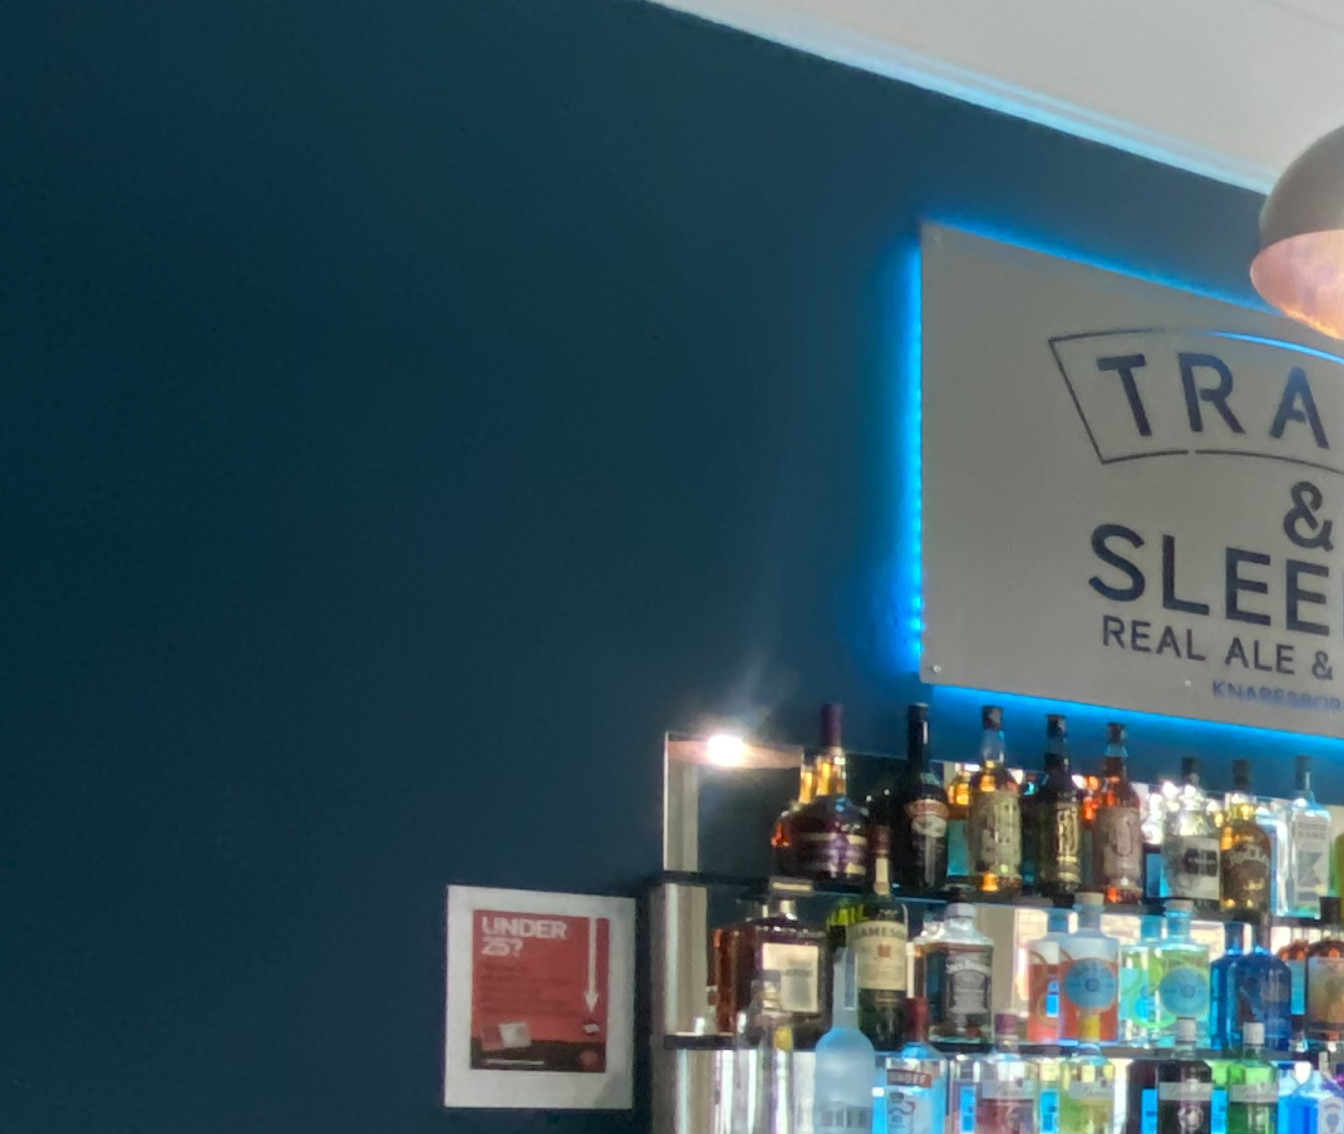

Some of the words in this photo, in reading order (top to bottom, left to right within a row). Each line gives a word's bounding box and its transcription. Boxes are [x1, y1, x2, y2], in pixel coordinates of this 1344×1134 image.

[1283, 481, 1334, 552] &
[1102, 614, 1206, 662] REAL
[1224, 637, 1296, 676] ALE
[1311, 651, 1334, 681] &
[481, 915, 568, 940] UNDER
[481, 937, 524, 957] 25?
